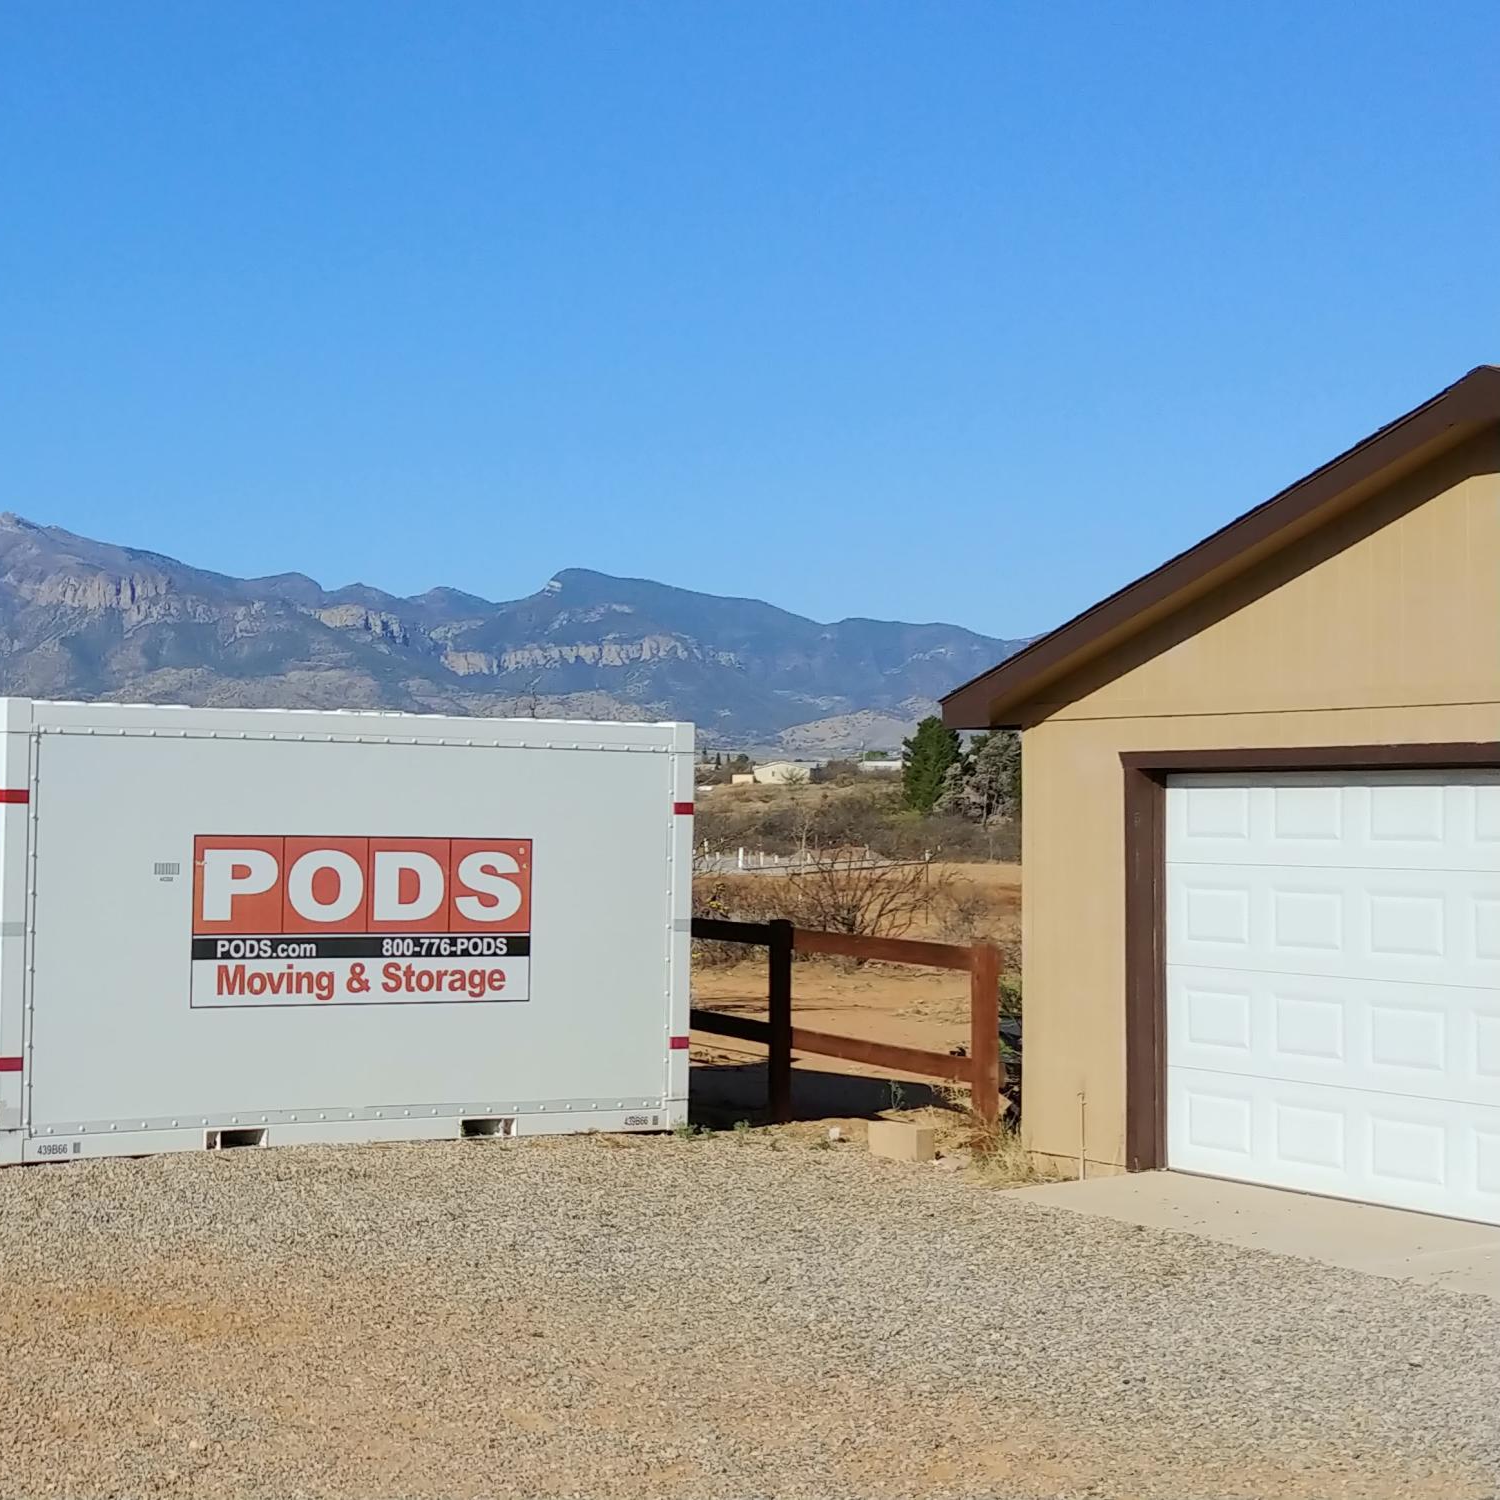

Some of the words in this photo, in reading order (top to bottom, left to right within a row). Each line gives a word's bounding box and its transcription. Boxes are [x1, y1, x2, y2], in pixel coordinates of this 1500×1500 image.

[202, 848, 523, 923] PODS
[216, 939, 317, 958] PODS.com
[381, 938, 508, 956] 800-776-PODS
[216, 963, 335, 1001] Moving
[346, 962, 371, 994] &
[381, 961, 507, 998] Storage
